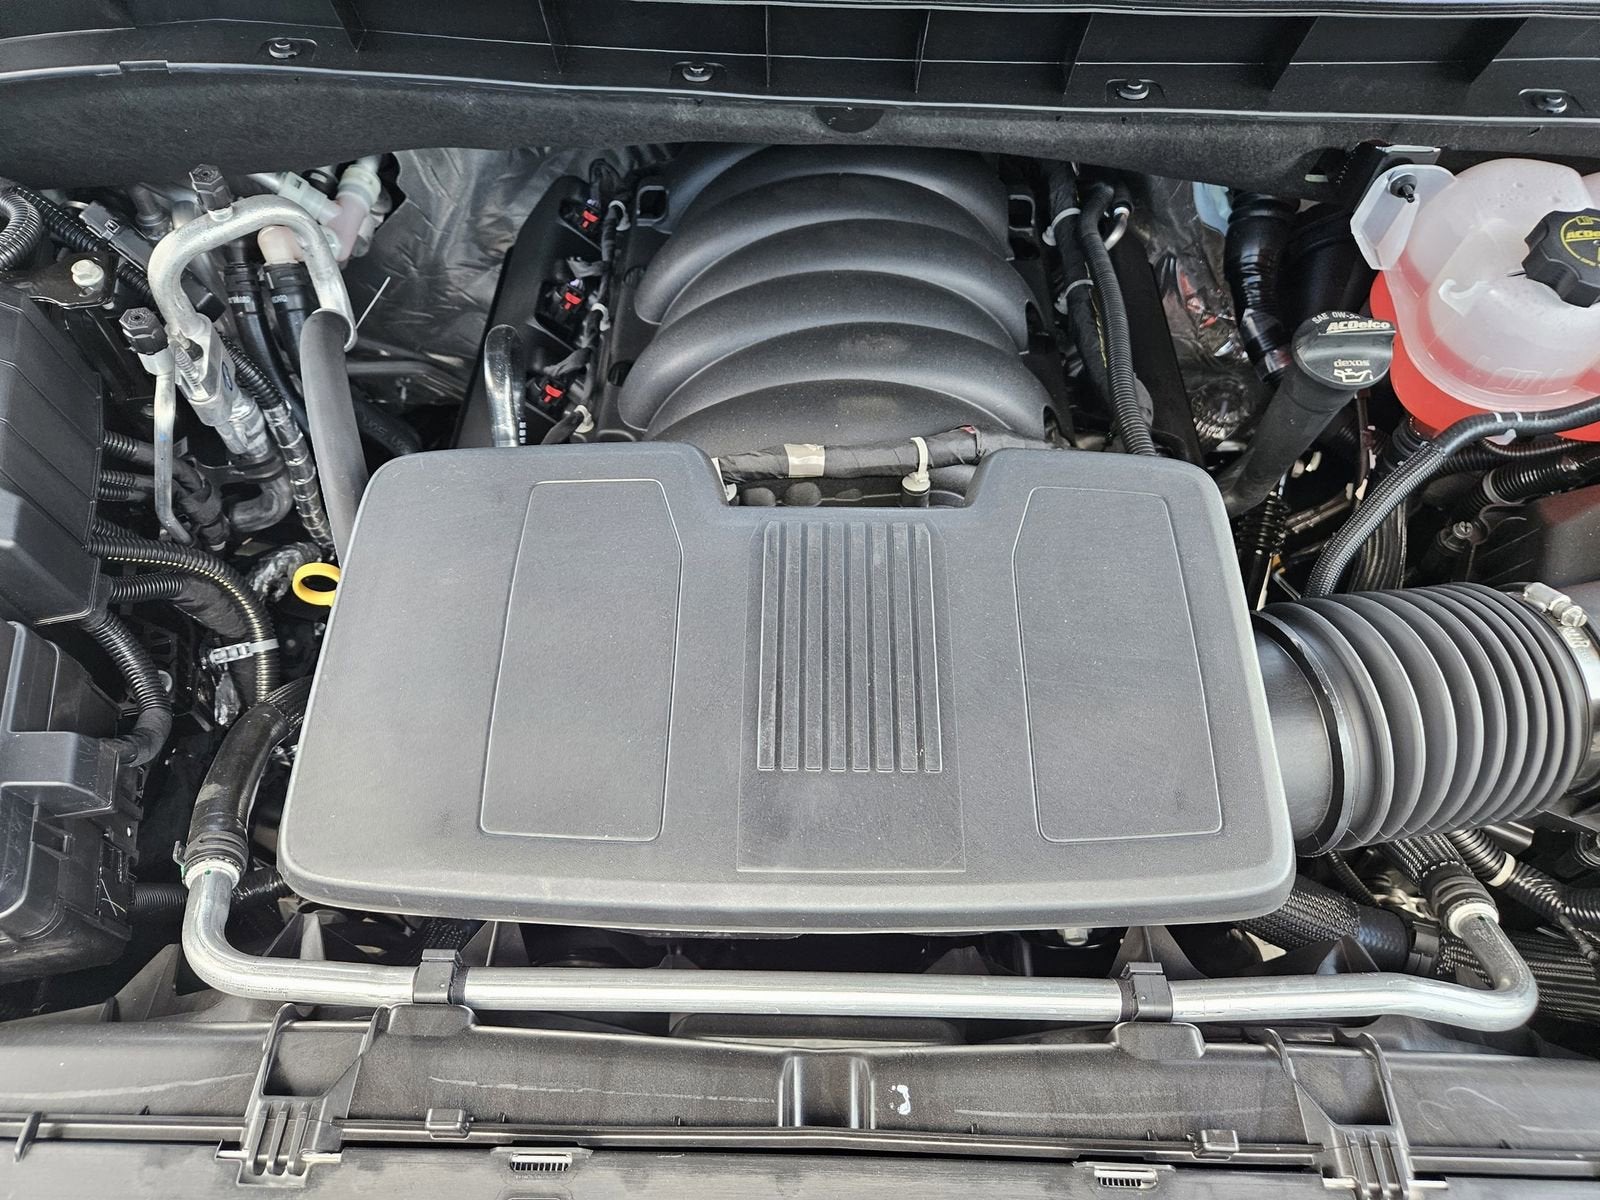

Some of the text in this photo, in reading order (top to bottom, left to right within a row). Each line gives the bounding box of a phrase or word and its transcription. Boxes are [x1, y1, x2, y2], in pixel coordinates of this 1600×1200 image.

[1312, 313, 1329, 324] SAE
[1326, 320, 1391, 331] ACDelco
[1334, 359, 1370, 367] dexos
